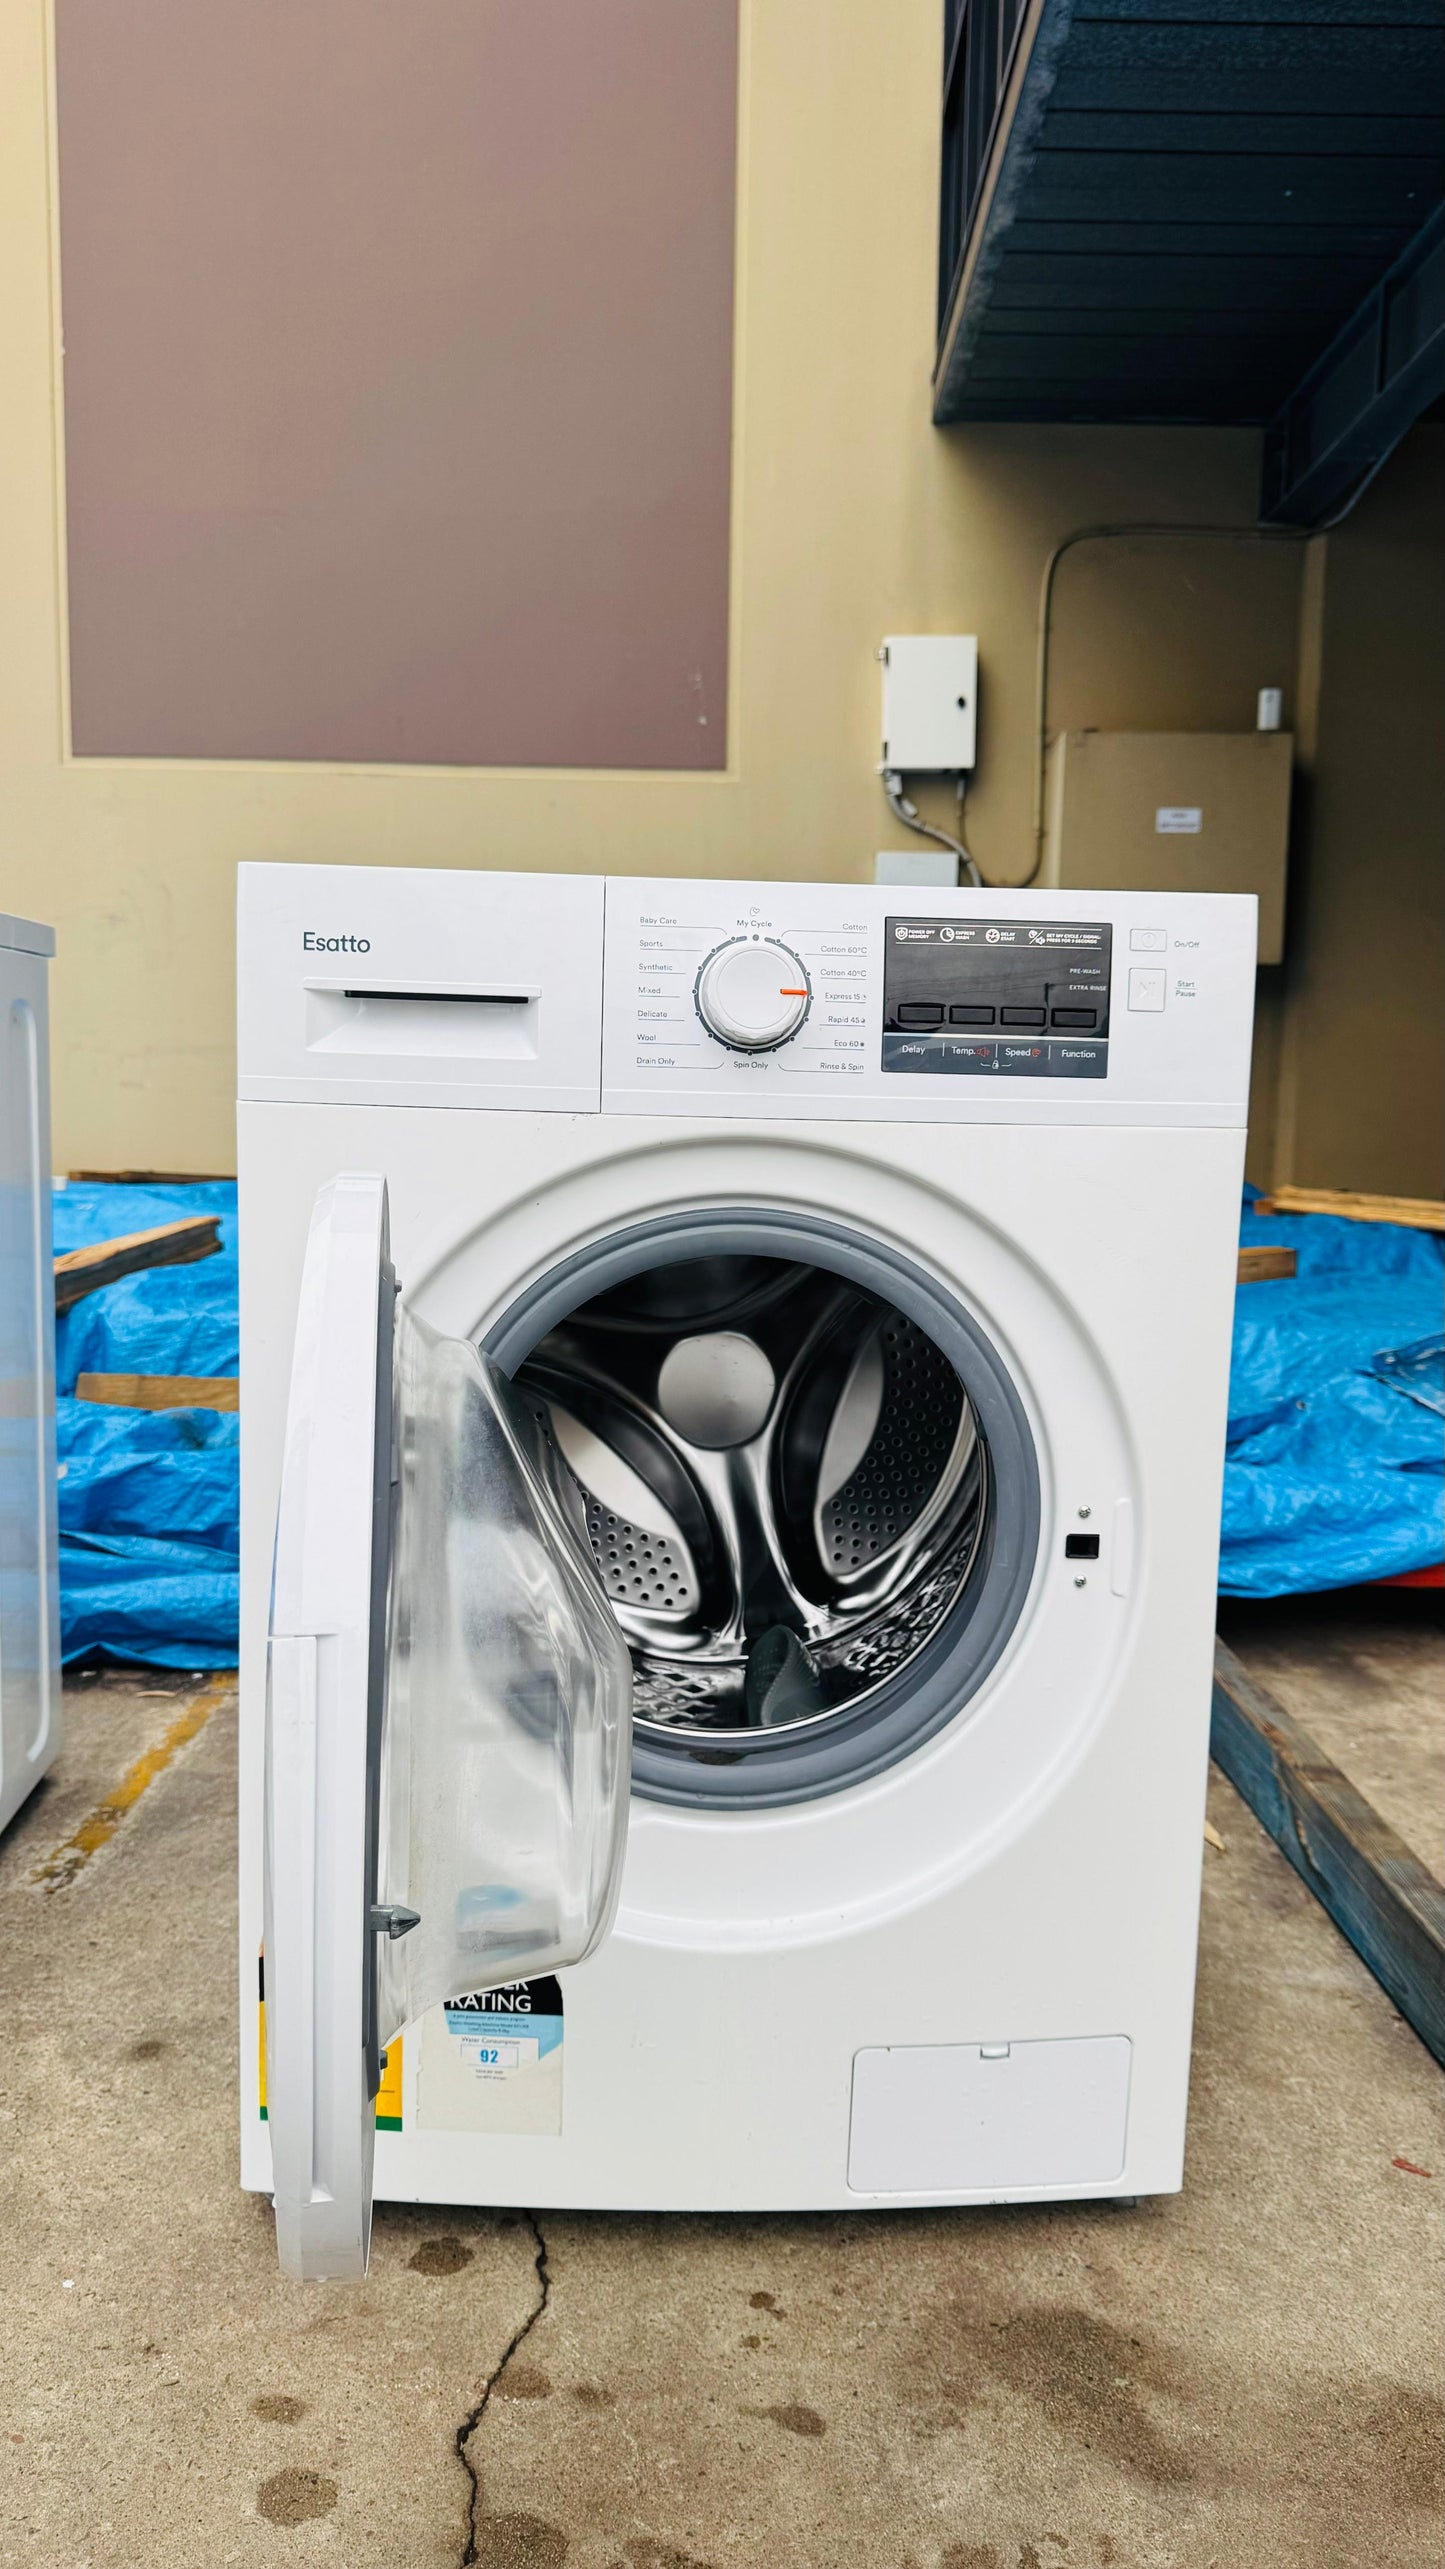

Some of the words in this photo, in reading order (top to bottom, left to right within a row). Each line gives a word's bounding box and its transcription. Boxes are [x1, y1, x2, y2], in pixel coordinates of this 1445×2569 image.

[640, 916, 657, 924] Baby
[737, 919, 748, 928] My
[750, 920, 772, 928] Cycle
[303, 931, 370, 953] Esatto
[640, 940, 663, 948] Sports
[639, 963, 672, 971] Synthetic
[638, 1010, 668, 1018] Delicate
[902, 1045, 926, 1055] Delay
[952, 1047, 976, 1056] Temp.
[1006, 1048, 1030, 1058] Speed
[1062, 1050, 1096, 1058] Function
[658, 1058, 675, 1066] Only
[751, 1062, 768, 1070] Only
[480, 2049, 498, 2063] 92
